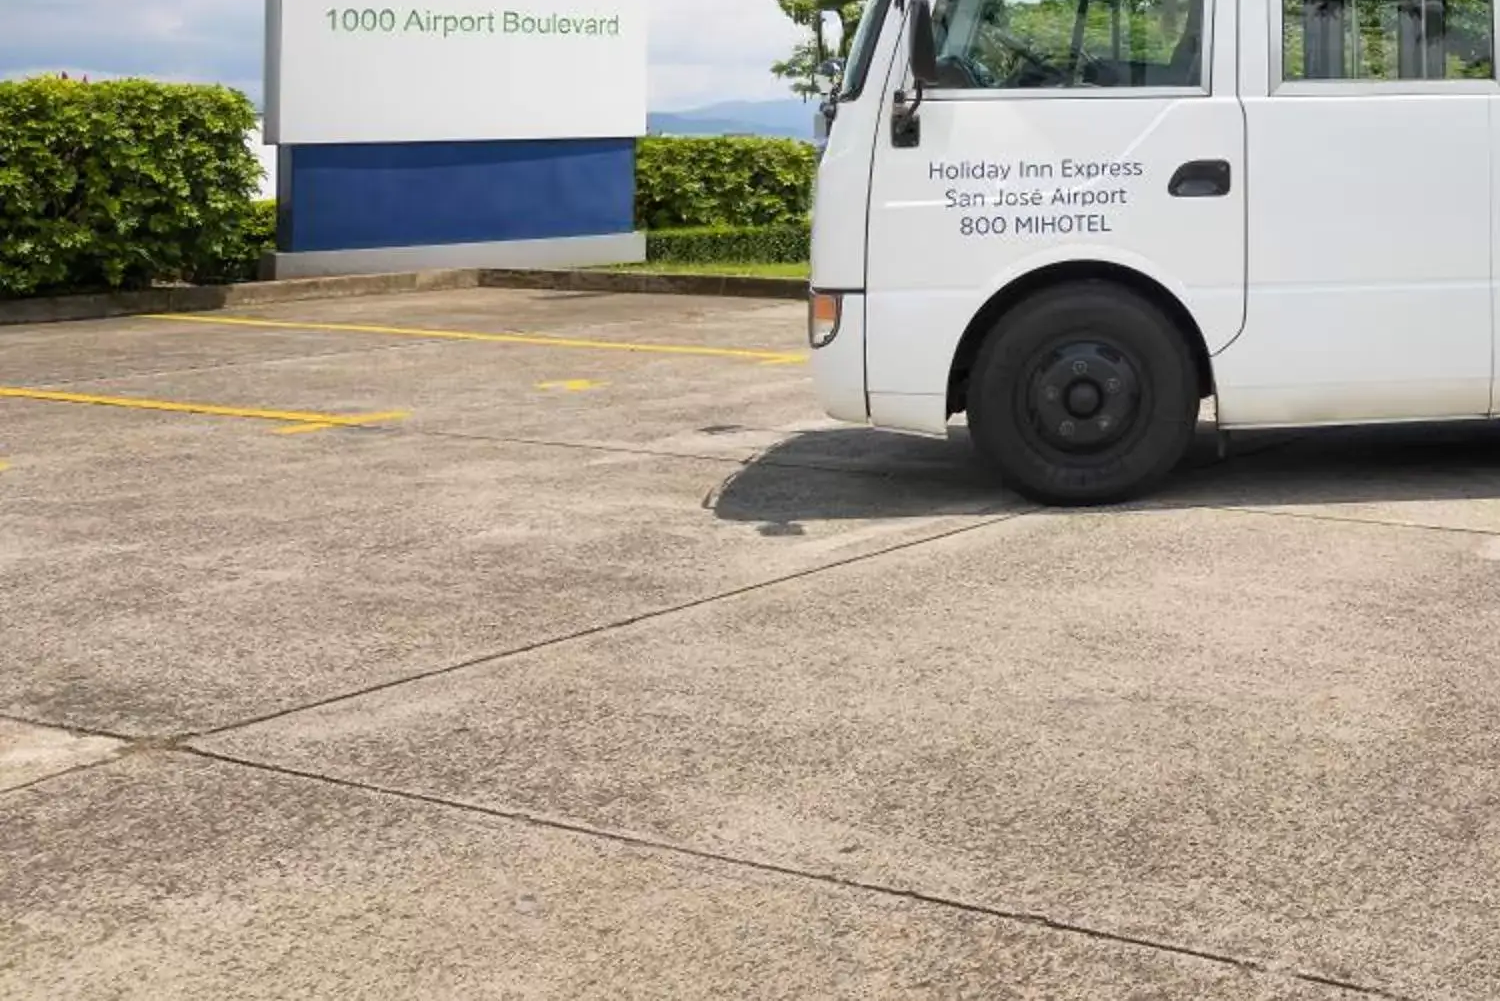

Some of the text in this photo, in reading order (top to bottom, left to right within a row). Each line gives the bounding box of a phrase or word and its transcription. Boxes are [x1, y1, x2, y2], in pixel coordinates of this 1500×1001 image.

[326, 8, 619, 37] 1000 Airport Boulevard
[929, 159, 1143, 180] Holiday Inn Express
[945, 187, 1127, 208] San José Airport
[959, 214, 1112, 236] 800 MIHOTEL
